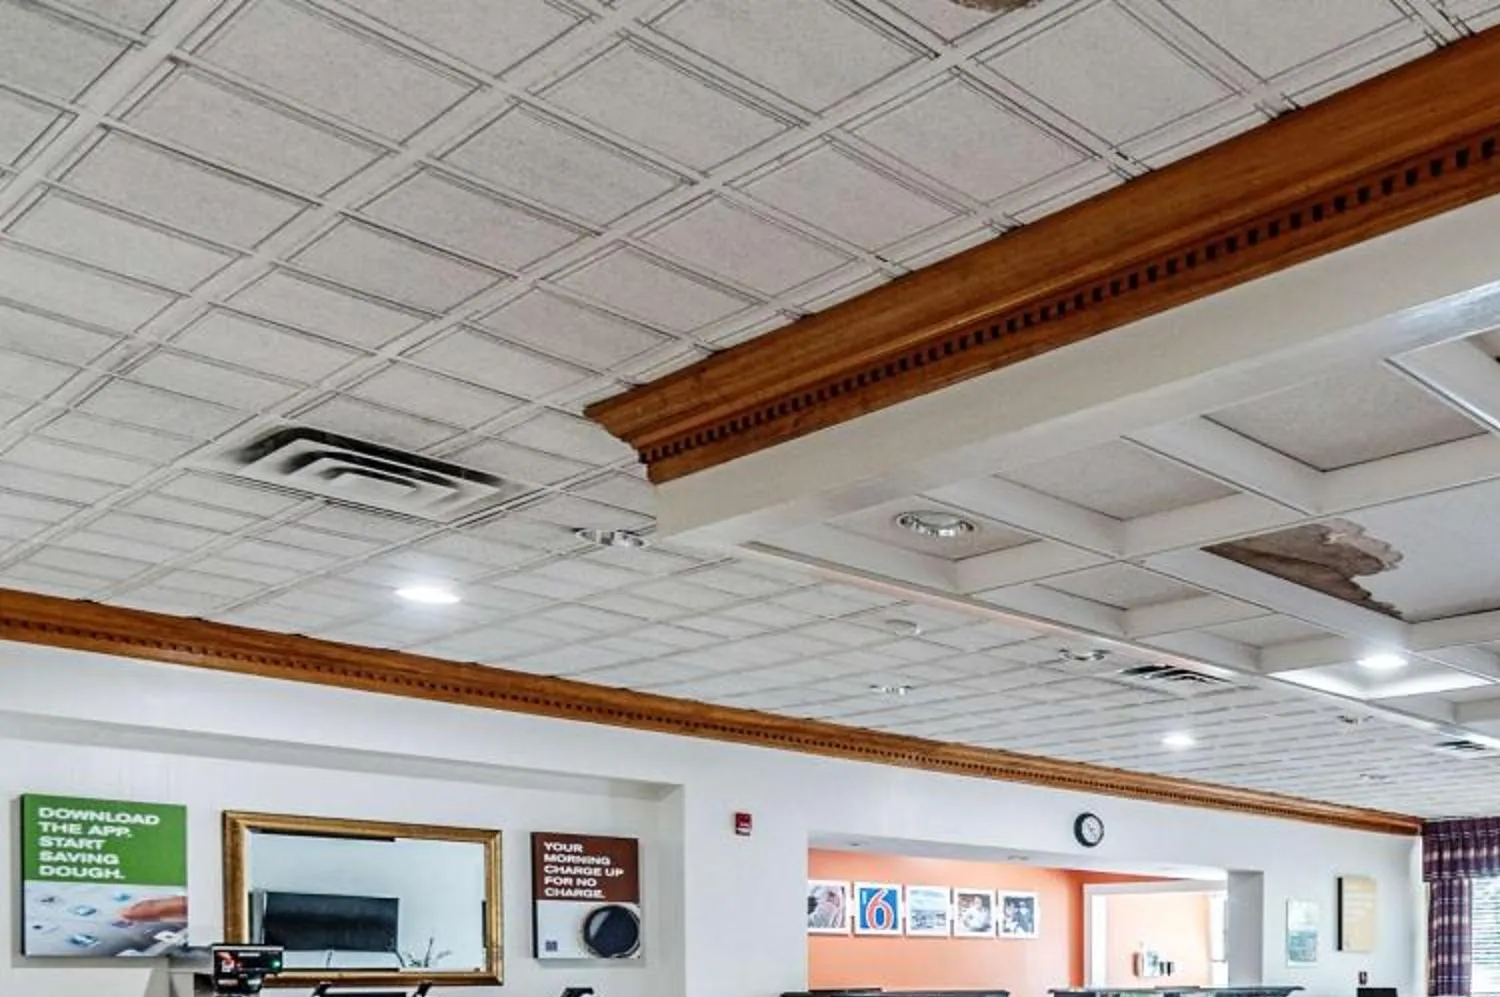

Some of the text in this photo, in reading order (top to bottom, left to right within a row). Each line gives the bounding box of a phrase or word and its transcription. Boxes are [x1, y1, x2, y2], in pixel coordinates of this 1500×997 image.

[37, 807, 160, 826] DOWNLOAD
[38, 821, 133, 838] THE APP.
[38, 836, 107, 850] START
[543, 841, 583, 853] YOUR
[38, 850, 120, 865] SAVING
[543, 854, 611, 866] MORNING
[39, 865, 126, 879] DOUGH.
[543, 865, 624, 877] CHARGE UP
[544, 876, 597, 887] FOR NO
[544, 888, 606, 898] CHARGE.
[865, 888, 894, 929] 6
